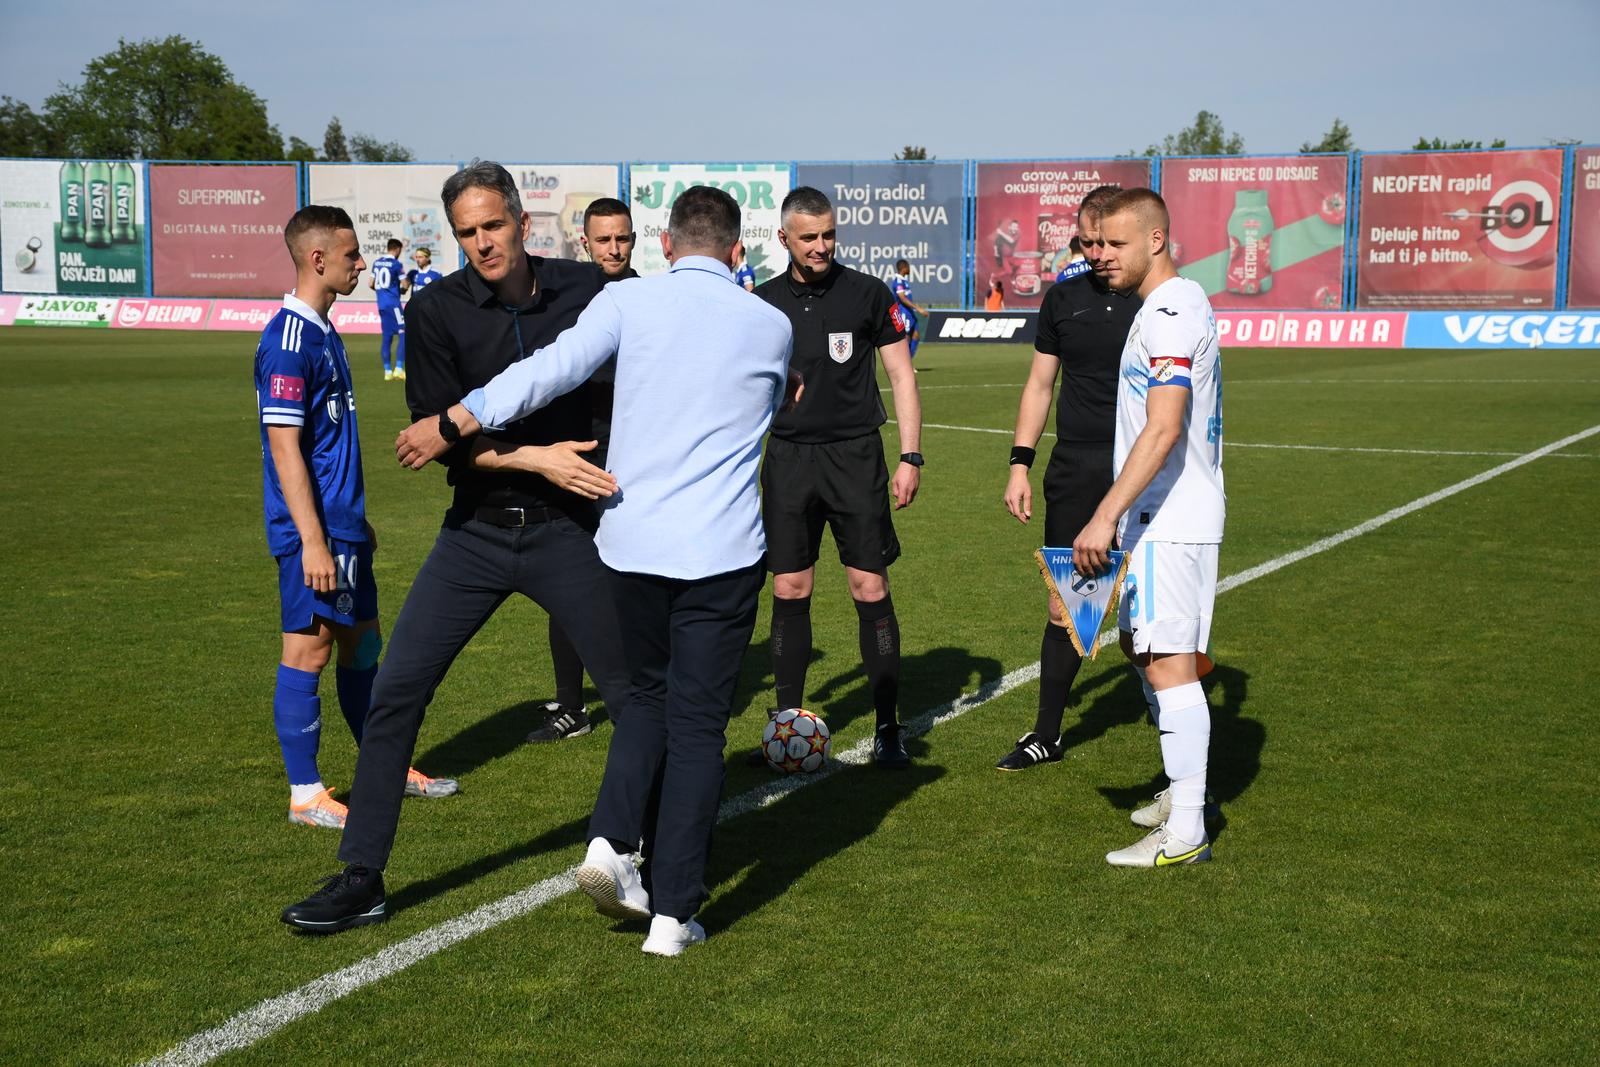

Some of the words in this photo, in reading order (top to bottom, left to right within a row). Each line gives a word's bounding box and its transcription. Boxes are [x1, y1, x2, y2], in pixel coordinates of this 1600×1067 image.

[521, 171, 560, 191] Lino
[1022, 172, 1069, 181] GOTOVA
[1072, 171, 1100, 181] JELA
[1188, 167, 1218, 182] SPASI
[1220, 166, 1256, 182] NEPCE
[1258, 166, 1274, 182] OD
[1275, 166, 1319, 181] DOSADE
[1004, 183, 1039, 194] OKUSI
[1372, 175, 1442, 193] NEOFEN
[1447, 174, 1492, 195] rapid
[67, 183, 79, 217] PAN
[91, 182, 104, 219] PAN
[117, 185, 128, 218] PAN
[178, 189, 253, 205] SUPERPRINT
[834, 185, 870, 204] Tvoj
[875, 184, 925, 201] radio!
[359, 213, 370, 224] NE
[879, 206, 949, 225] DRAVA
[1480, 201, 1553, 229] BOL
[163, 225, 226, 234] DIGITALNA
[232, 225, 284, 234] TISKARA
[1371, 227, 1418, 244] Djeluje
[1422, 226, 1460, 241] hitno
[60, 252, 86, 267] PAN.
[870, 242, 928, 262] portal!
[1370, 249, 1395, 263] kad
[1399, 249, 1409, 262] ti
[1413, 249, 1427, 265] je
[1431, 248, 1473, 262] bitno.
[61, 266, 106, 283] OSVJEŽI
[109, 269, 136, 283] DAN!
[37, 300, 98, 313] JAVOR
[145, 305, 203, 323] BELUPO
[938, 317, 1027, 339] ROST
[1217, 319, 1390, 343] PODRAVKA
